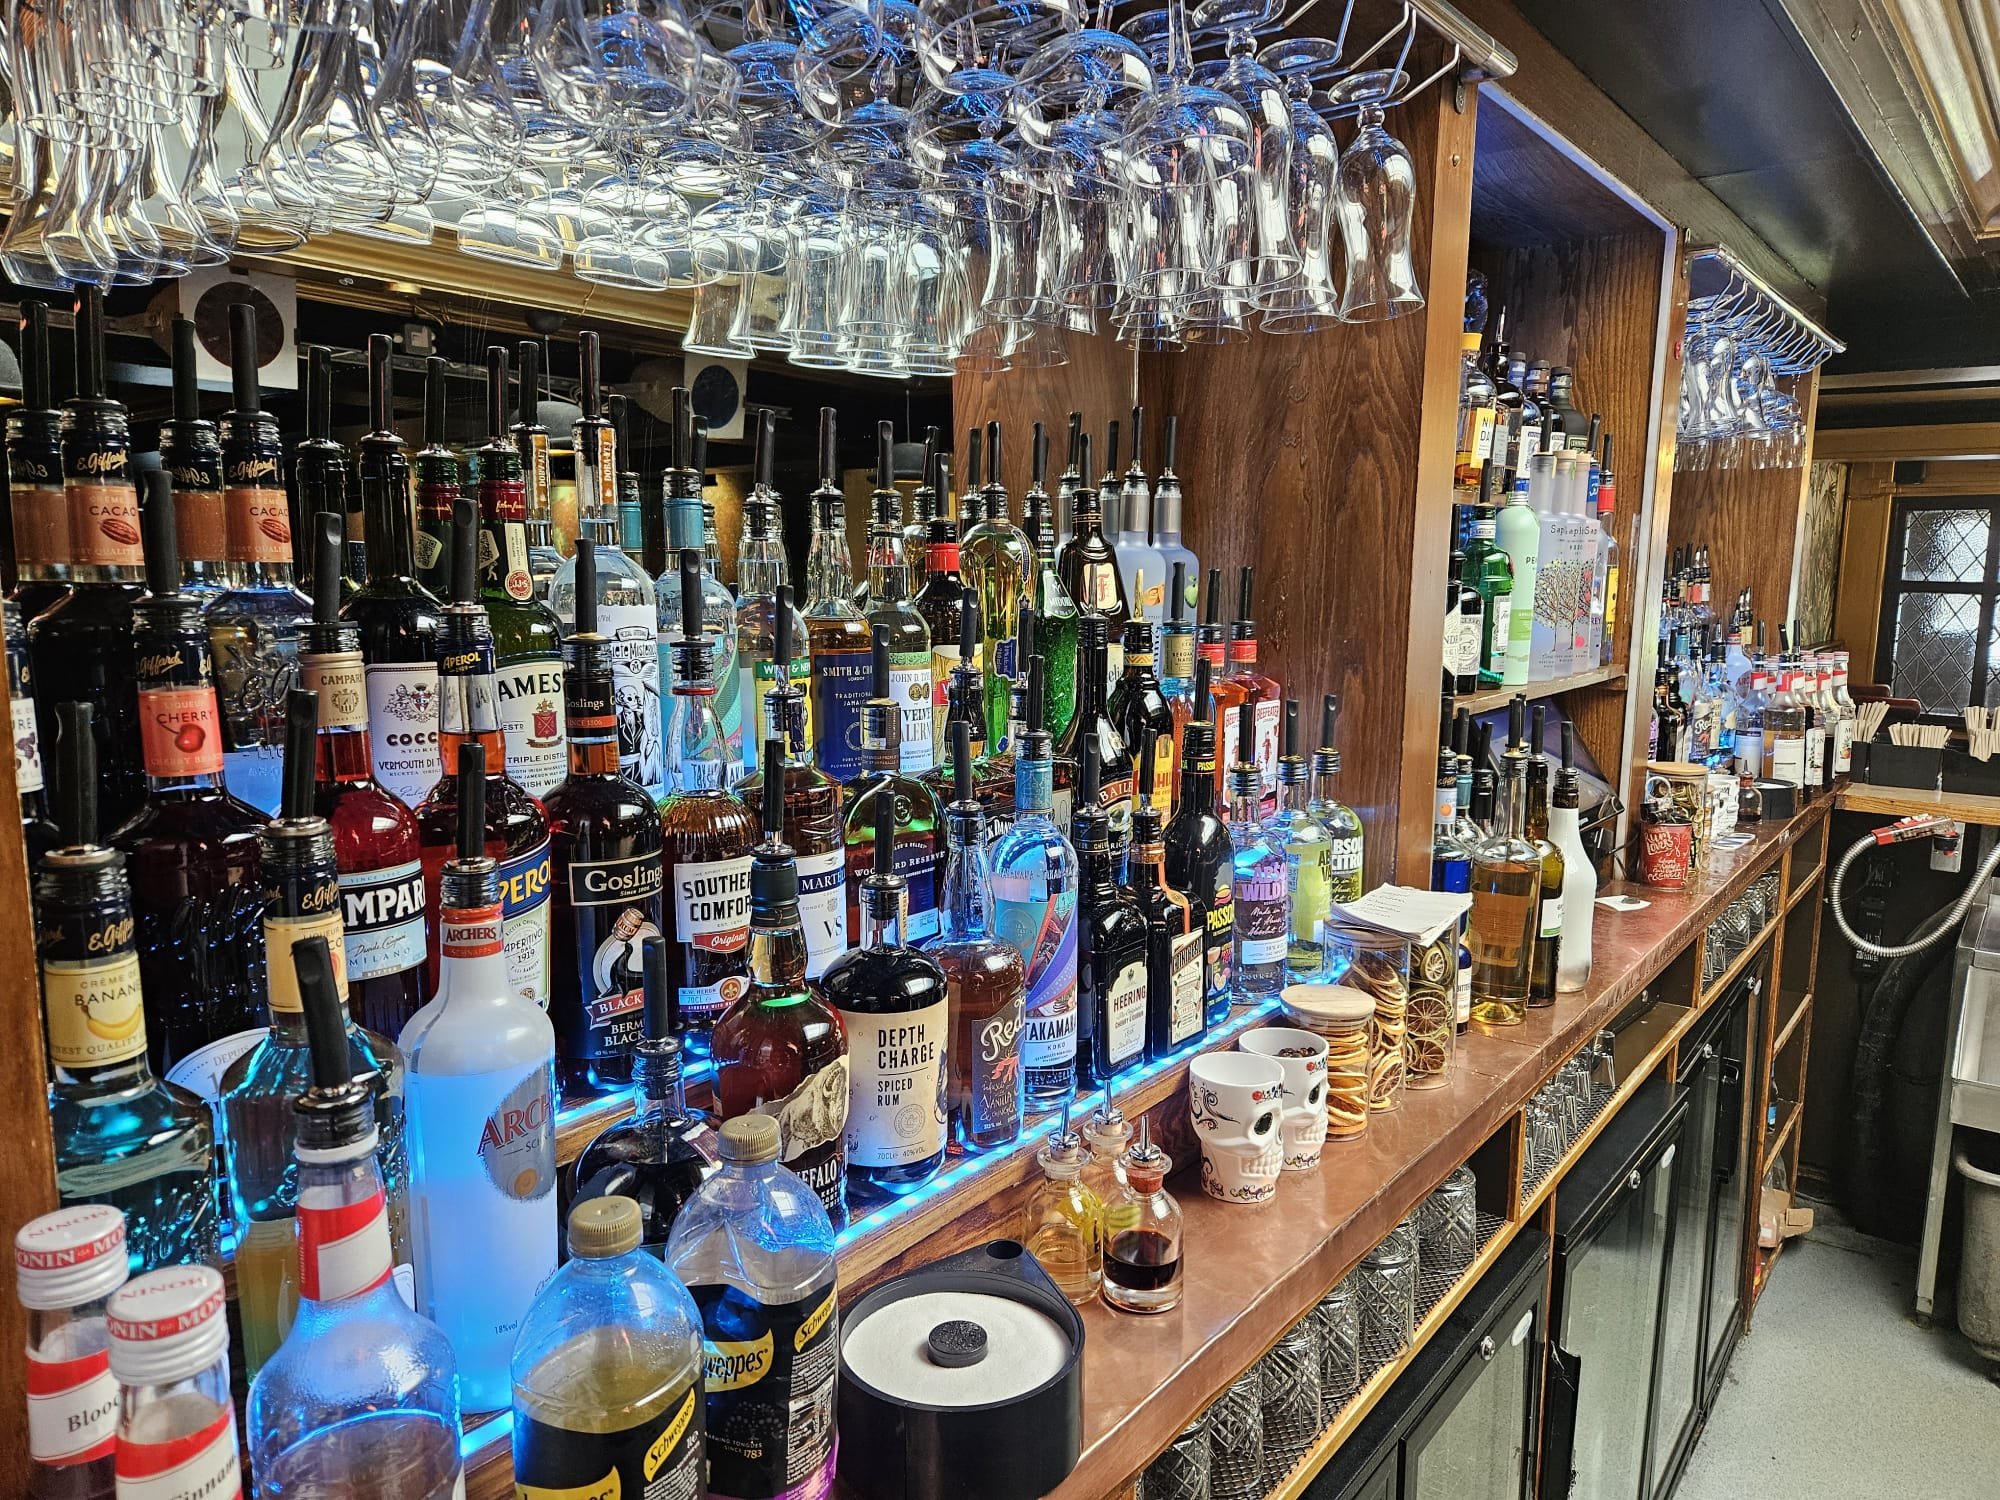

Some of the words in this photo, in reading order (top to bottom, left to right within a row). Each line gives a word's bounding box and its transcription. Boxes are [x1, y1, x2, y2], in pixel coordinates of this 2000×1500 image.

[443, 651, 482, 670] APEROL
[823, 666, 852, 677] SMITH
[854, 665, 861, 676] &
[498, 671, 563, 702] AMES
[156, 710, 213, 725] CHERRY
[386, 731, 439, 748] COCC
[900, 722, 932, 743] ALERN
[378, 759, 425, 771] VERMOUTH
[426, 758, 434, 767] DI
[507, 755, 541, 764] TRIPLE
[1197, 760, 1216, 771] PASSO
[543, 776, 565, 786] WHIS
[1100, 781, 1133, 802] BAILE
[1332, 837, 1364, 854] BSO
[854, 861, 906, 877] WOORD
[909, 851, 945, 867] RESERVE
[1332, 853, 1364, 871] CITRO
[499, 855, 551, 905] PERO
[801, 871, 846, 892] MARTEL
[341, 875, 426, 928] MPARI
[1242, 881, 1281, 902] WILD
[1206, 900, 1235, 932] PASSO
[446, 926, 497, 943] ARCHERS
[619, 922, 635, 934] RUM
[824, 915, 843, 939] VS
[504, 928, 543, 955] APERITIVO
[711, 931, 747, 948] Original
[349, 947, 411, 967] MILANO
[518, 948, 535, 964] 1919
[74, 978, 142, 1008] BANANE
[1113, 985, 1147, 1013] HEERING
[598, 994, 643, 1014] BLACK
[611, 1018, 646, 1035] BERM
[878, 1023, 925, 1048] DEPTH
[981, 995, 1026, 1062] Red
[1025, 1014, 1076, 1041] TAKAMAK
[604, 1029, 646, 1047] BLACK
[1047, 1041, 1066, 1051] KOKO
[878, 1042, 934, 1070] CHARGE
[877, 1078, 913, 1092] SPICED
[877, 1094, 901, 1107] RUM
[476, 1093, 550, 1157] ARCH
[28, 1210, 109, 1239] MONIN
[15, 1249, 76, 1269] ONIN
[106, 1318, 159, 1340] ONIN
[178, 1292, 225, 1332] MON
[704, 1348, 765, 1384] weppes
[649, 1397, 695, 1472] Schweppes
[732, 1439, 763, 1449] TONGUES
[724, 1445, 742, 1454] SINCE
[743, 1448, 763, 1460] 1783
